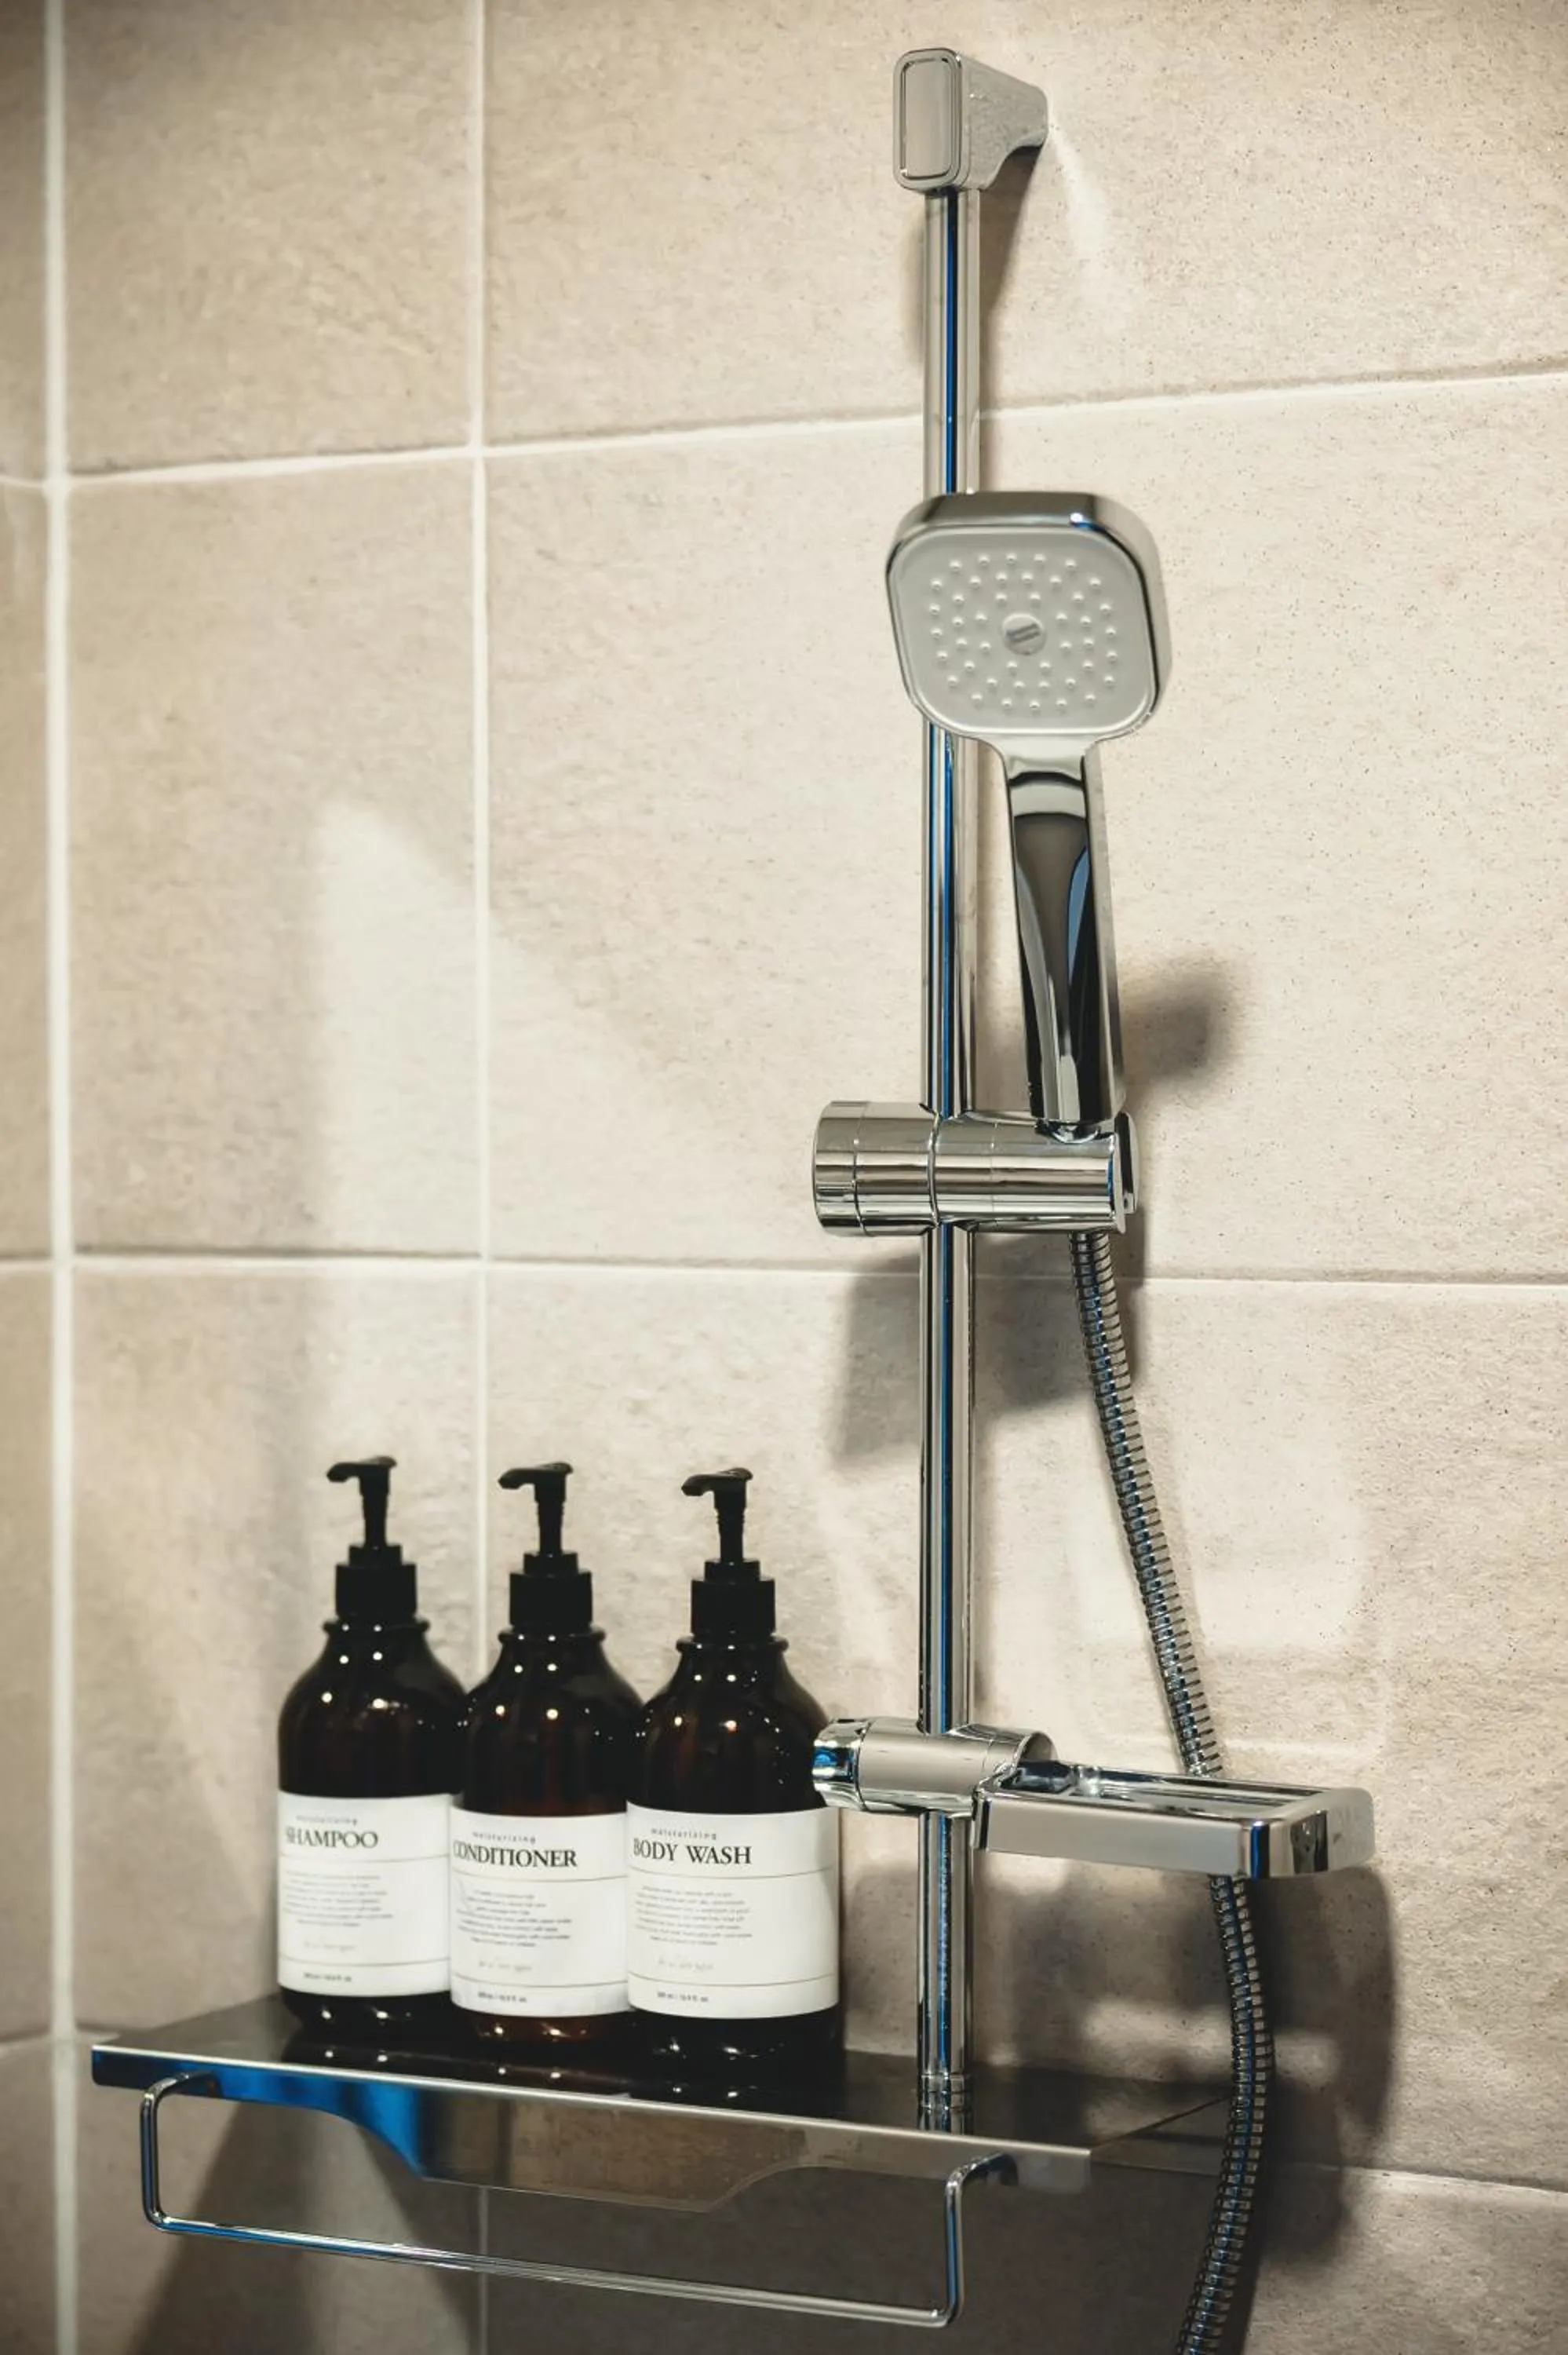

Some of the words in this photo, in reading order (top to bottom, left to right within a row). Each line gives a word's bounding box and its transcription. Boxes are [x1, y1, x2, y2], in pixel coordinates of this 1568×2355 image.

[286, 1826, 378, 1848] SHAMPOO
[453, 1840, 578, 1868] CONDITIONER
[633, 1838, 678, 1861] BODY
[684, 1845, 752, 1865] WASH
